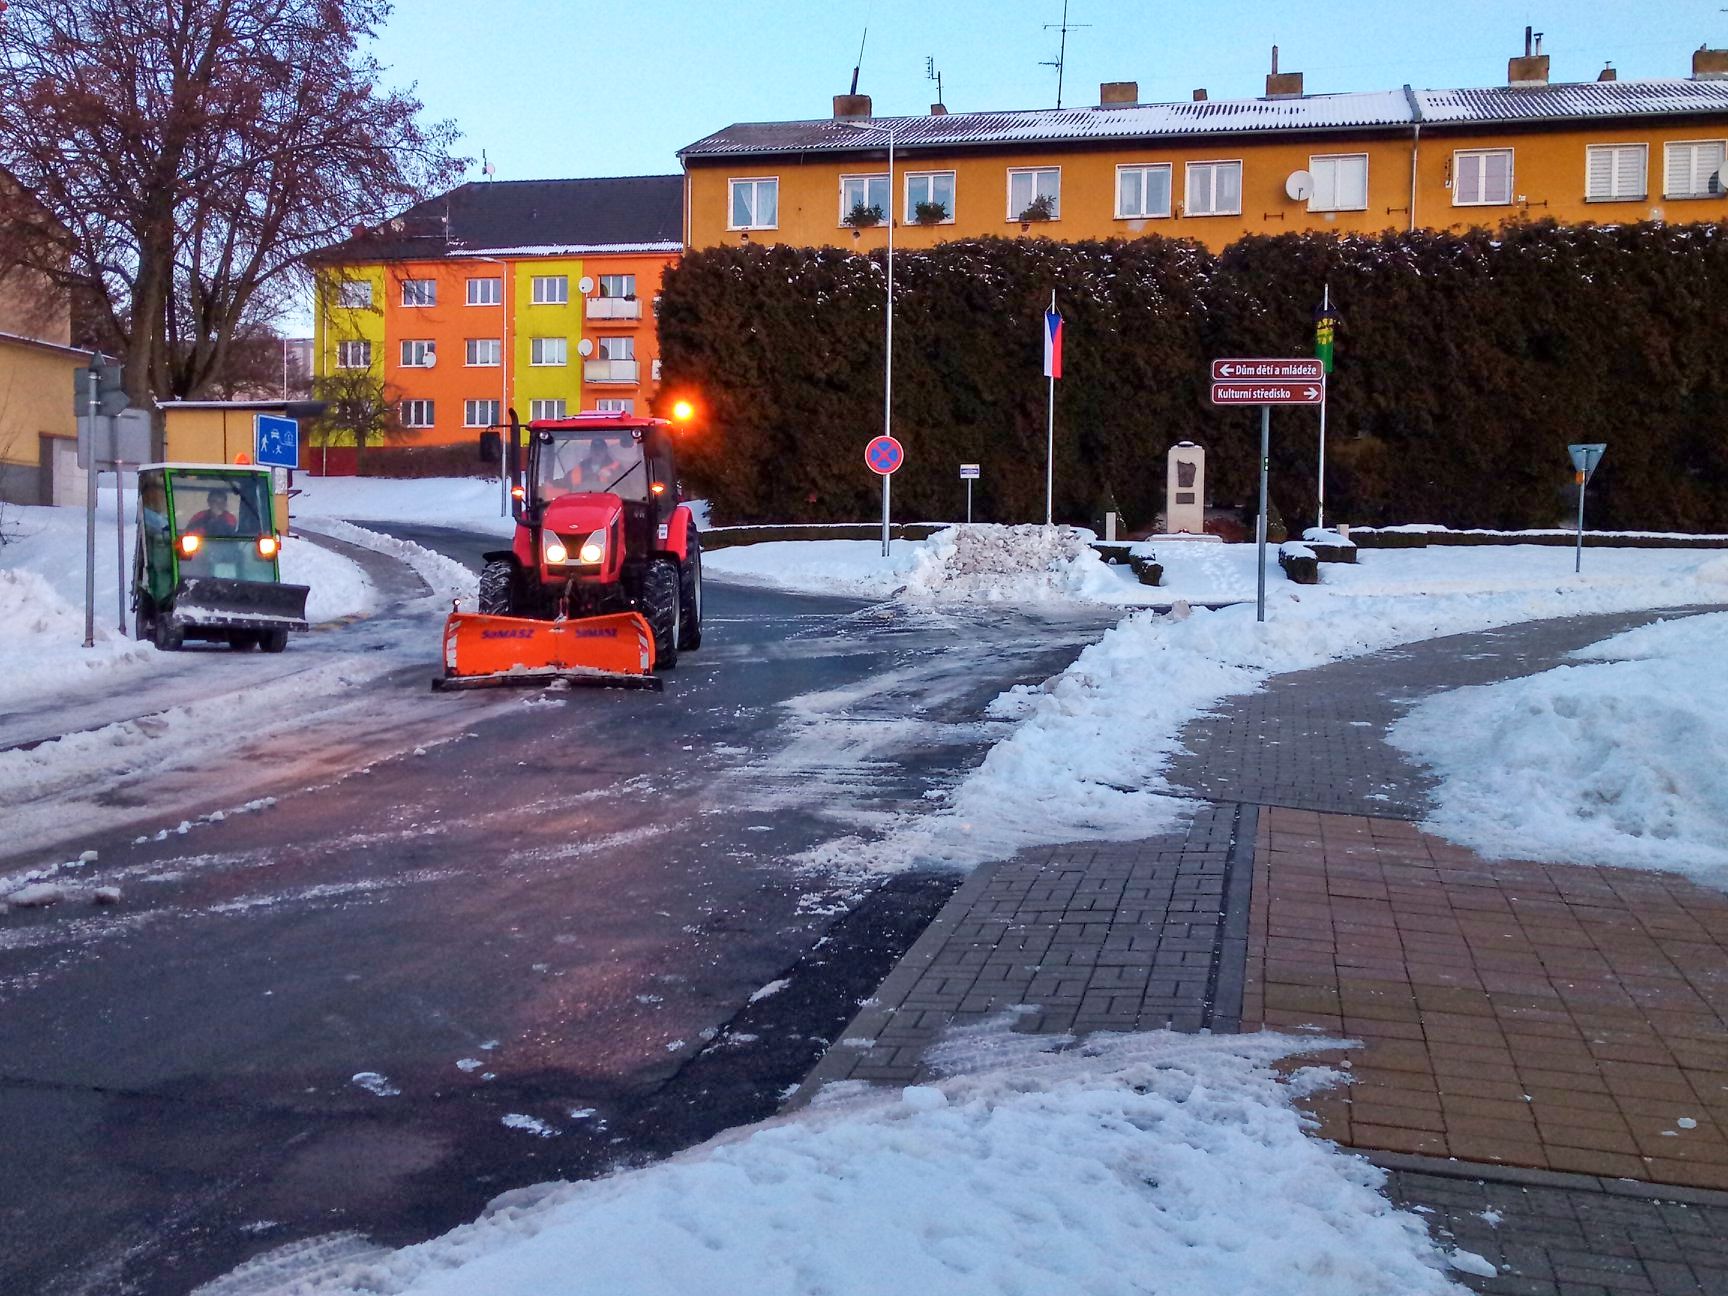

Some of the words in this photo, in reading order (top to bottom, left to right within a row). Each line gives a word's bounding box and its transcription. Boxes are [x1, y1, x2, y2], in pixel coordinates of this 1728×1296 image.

[1236, 364, 1255, 375] Dům
[1274, 367, 1280, 375] a
[1281, 364, 1317, 375] mládeže
[1217, 388, 1252, 399] Kulturní
[1252, 388, 1291, 399] středisko
